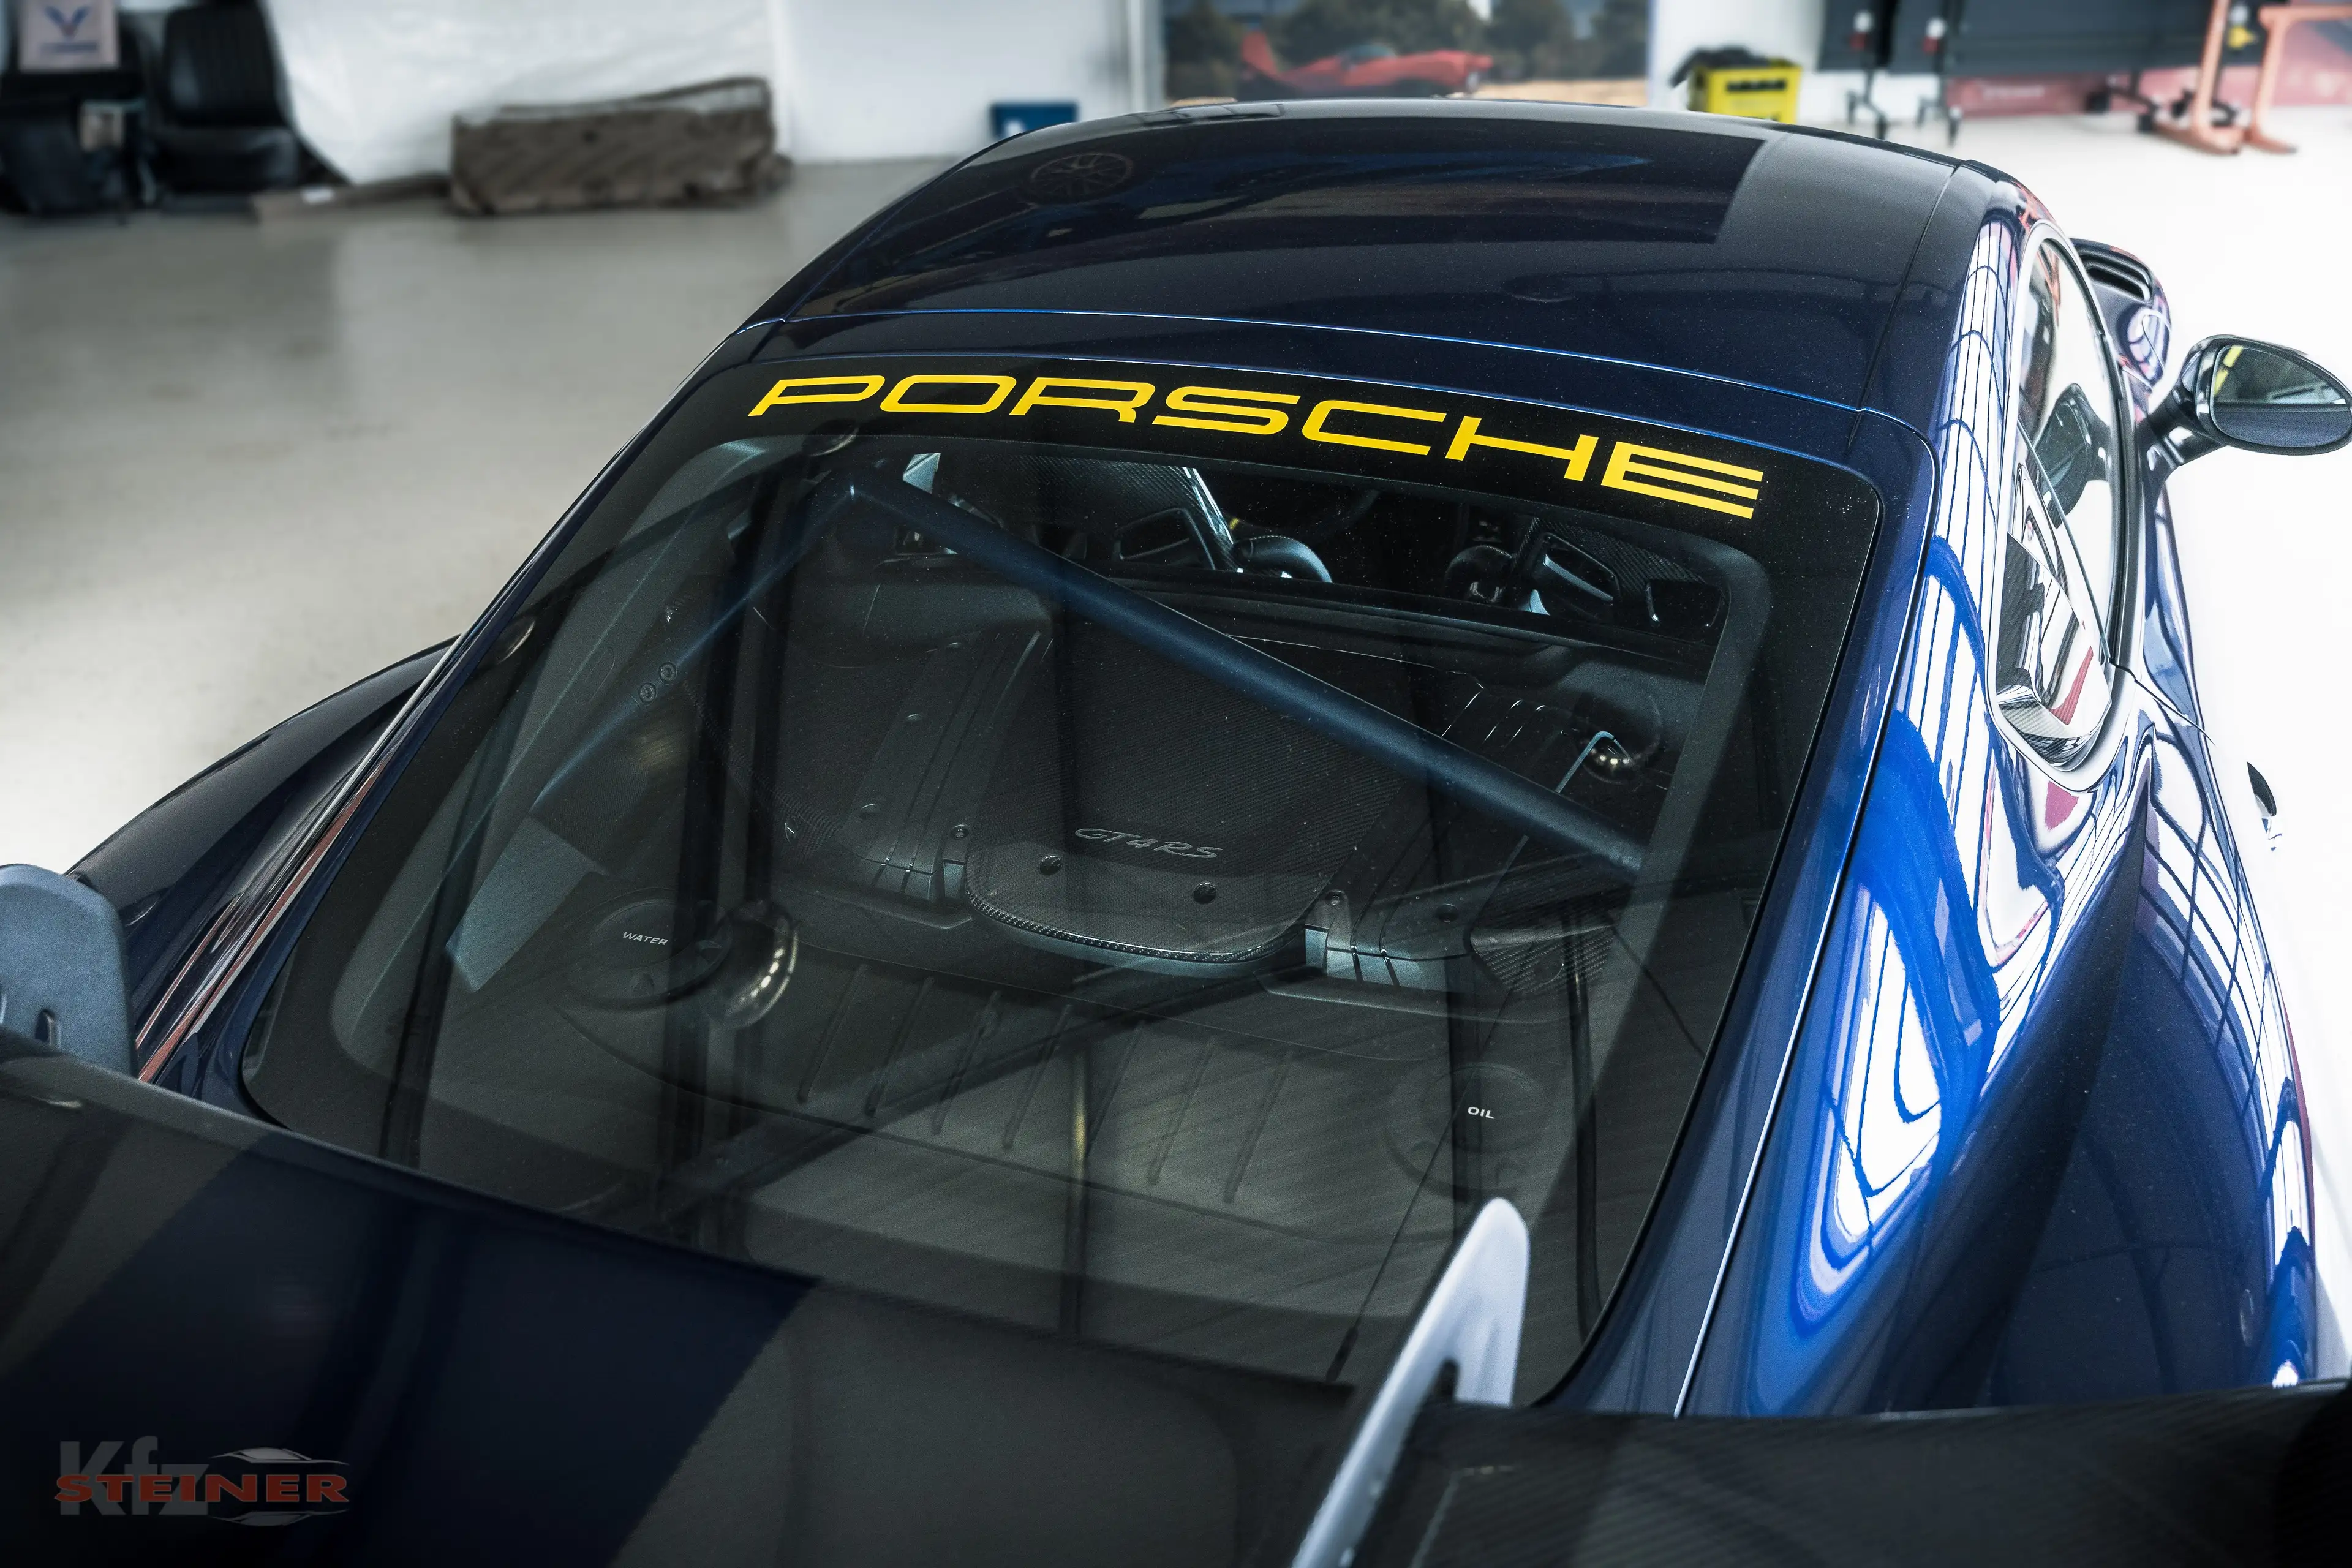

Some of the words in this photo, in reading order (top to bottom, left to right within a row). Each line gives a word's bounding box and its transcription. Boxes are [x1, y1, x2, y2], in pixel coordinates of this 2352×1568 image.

[748, 374, 1763, 519] PORSCHE
[623, 932, 668, 945] WATER
[1468, 1106, 1494, 1120] OIL
